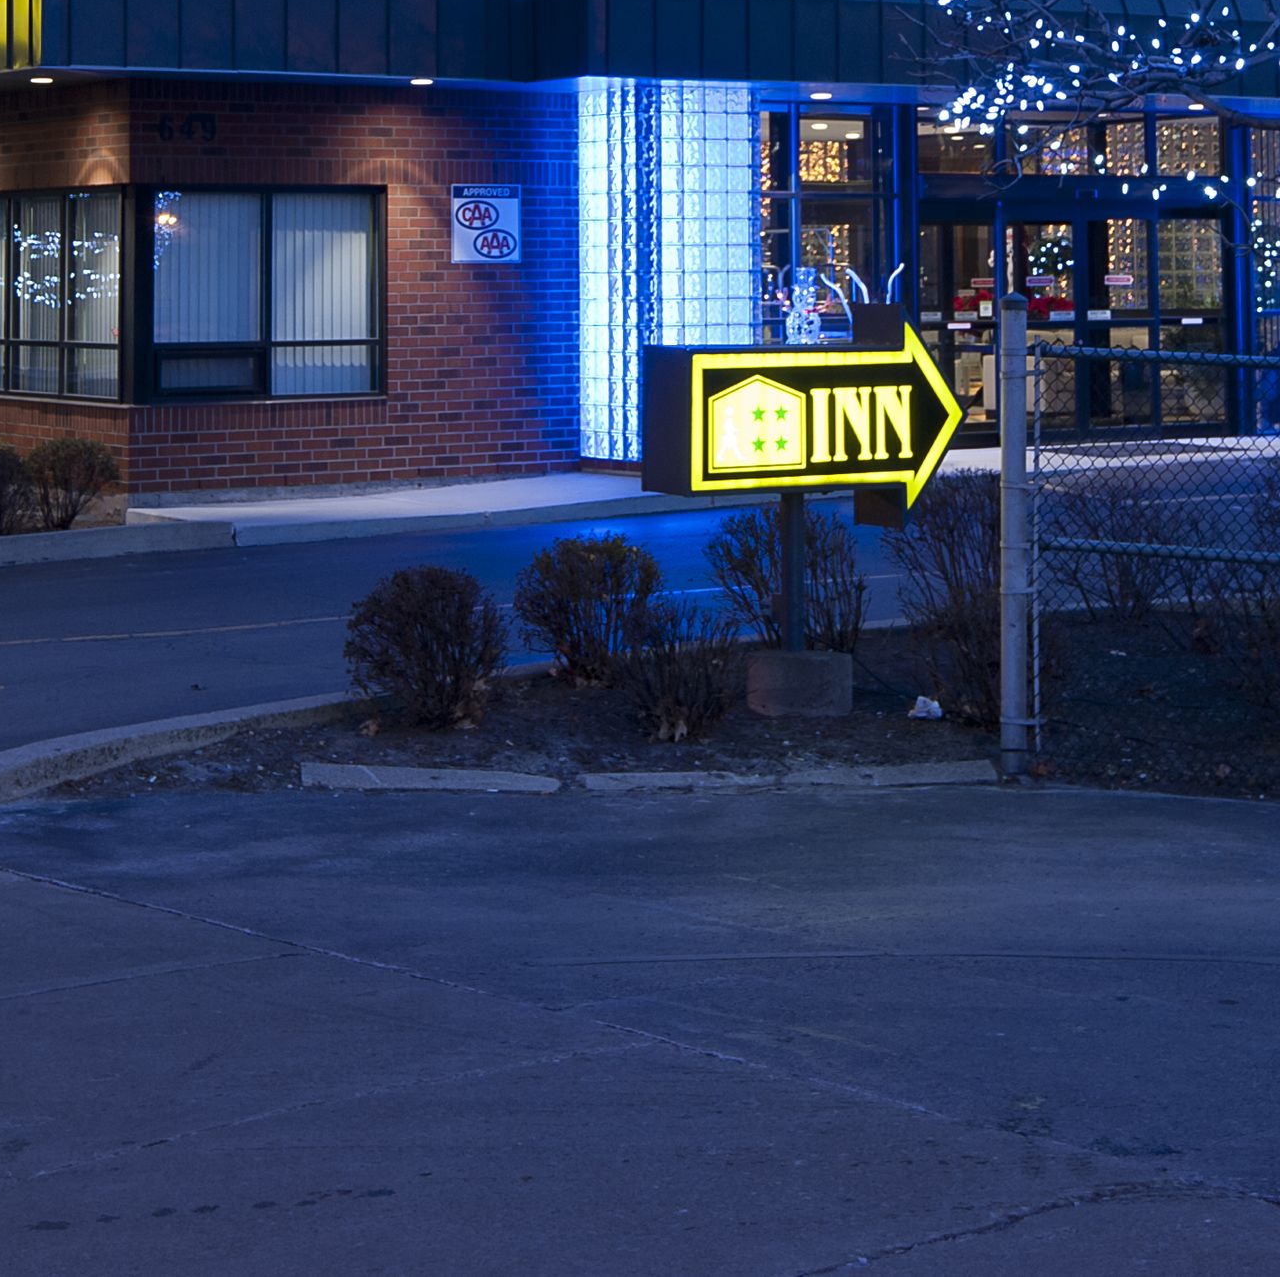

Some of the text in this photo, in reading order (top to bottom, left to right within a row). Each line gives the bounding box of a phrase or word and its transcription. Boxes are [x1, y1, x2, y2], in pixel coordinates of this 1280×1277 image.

[160, 113, 217, 141] 649
[462, 187, 510, 197] APPROVED
[462, 203, 492, 226] CAA
[480, 231, 511, 256] AAA
[810, 385, 913, 463] INN
